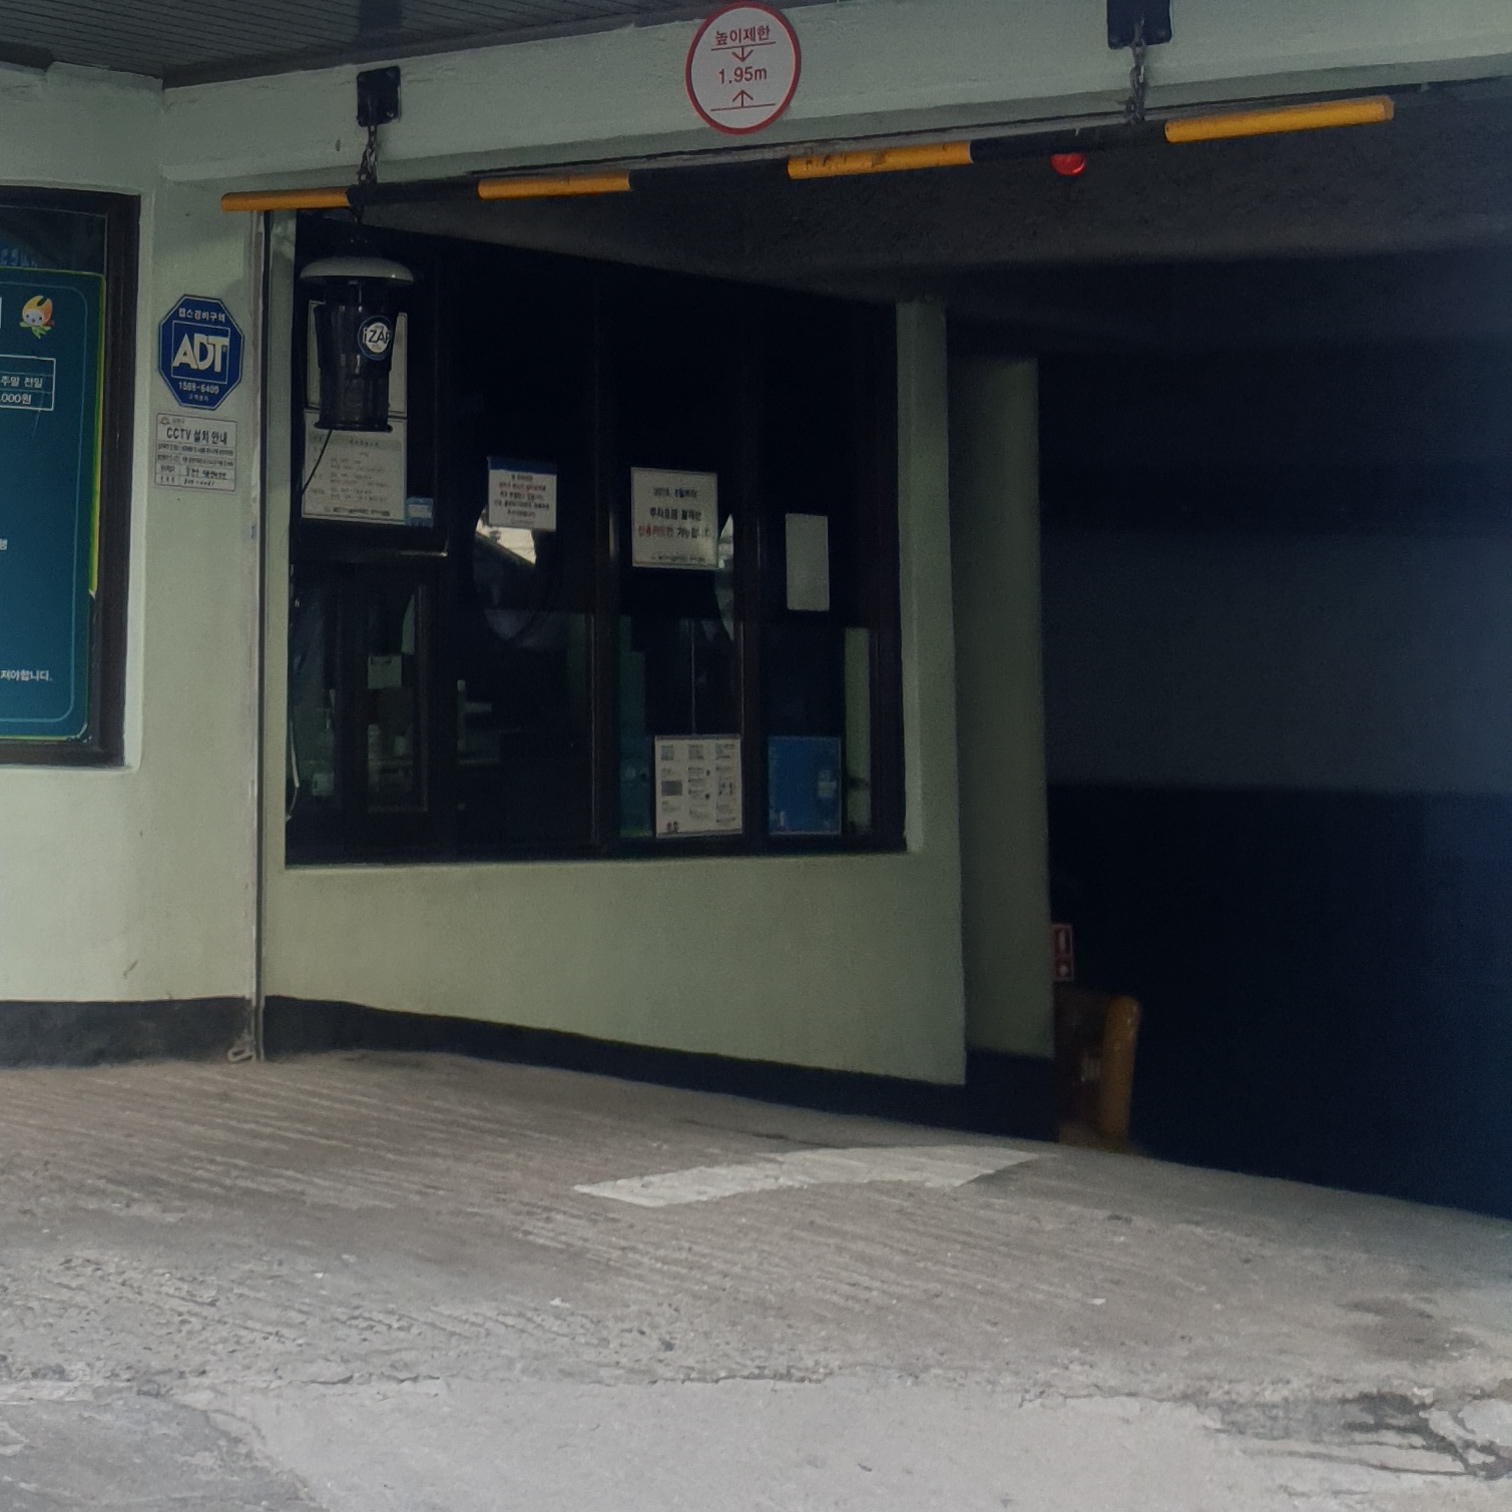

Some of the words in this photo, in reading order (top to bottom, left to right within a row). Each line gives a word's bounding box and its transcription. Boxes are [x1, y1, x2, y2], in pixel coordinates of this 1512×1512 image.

[716, 26, 771, 45] 높이제한
[718, 66, 768, 84] 1.95m
[172, 333, 230, 373] ADT
[166, 426, 192, 440] CCTV
[194, 429, 209, 444] 설치
[211, 430, 228, 445] 안내
